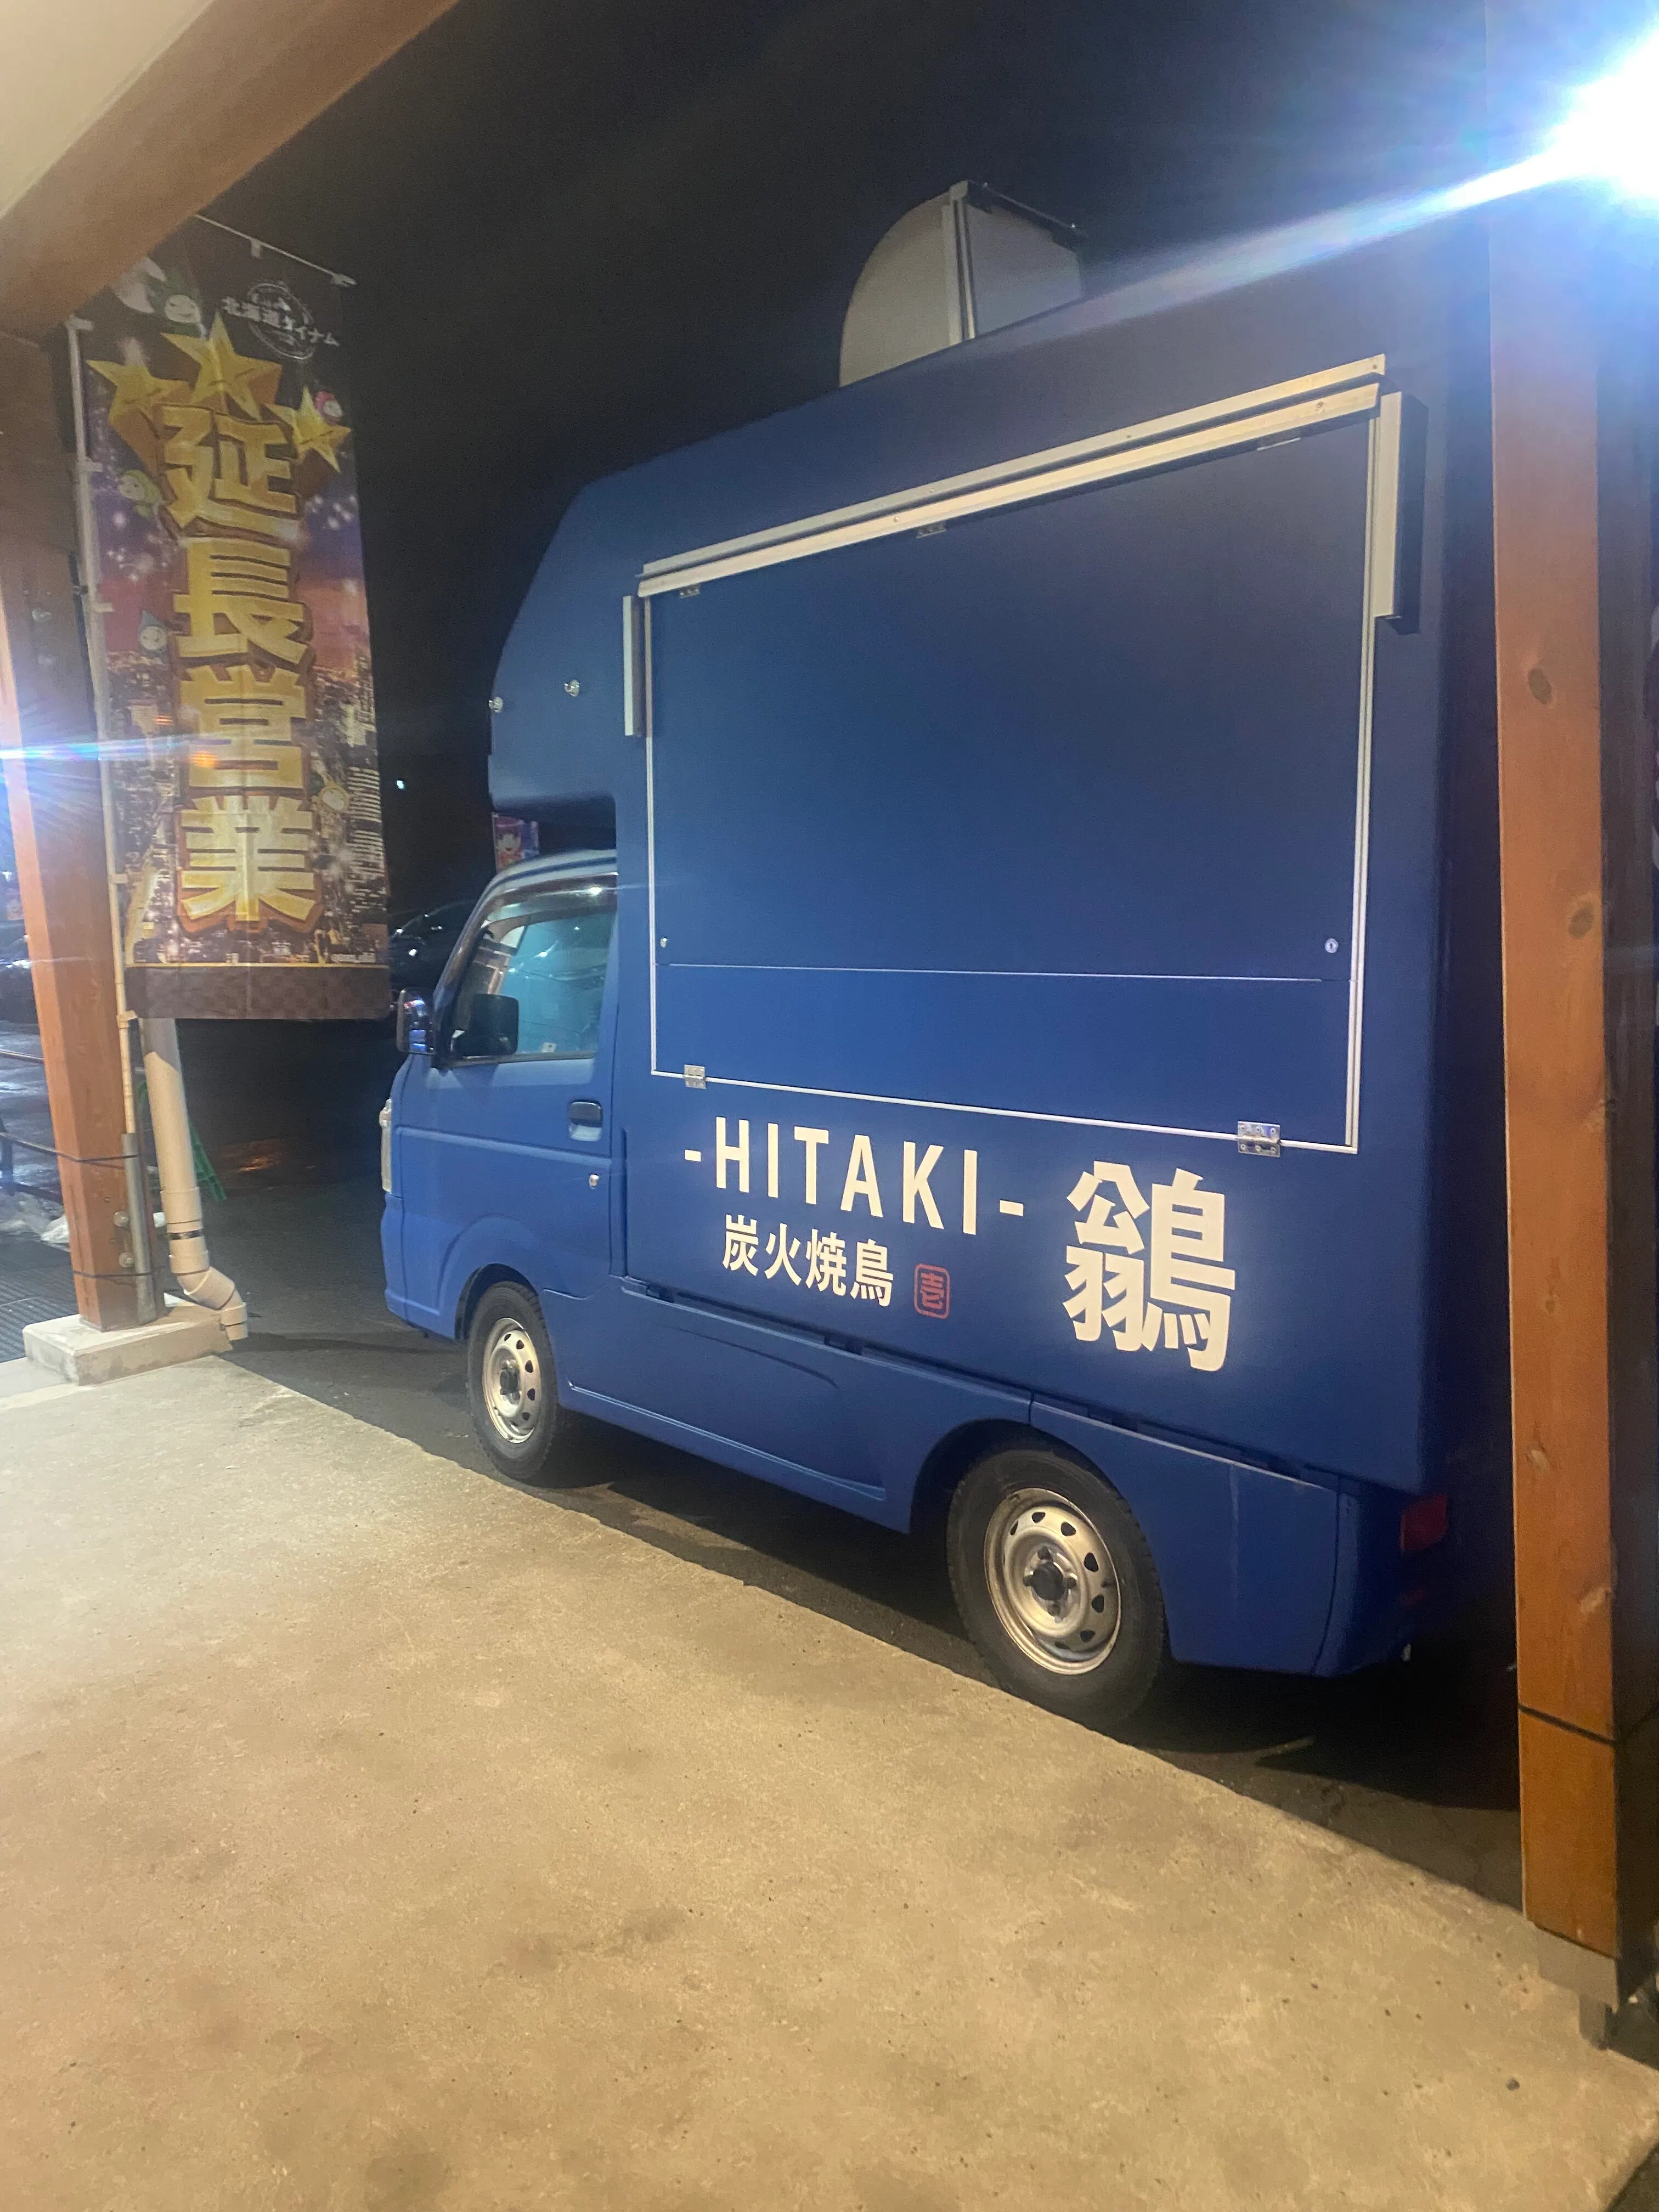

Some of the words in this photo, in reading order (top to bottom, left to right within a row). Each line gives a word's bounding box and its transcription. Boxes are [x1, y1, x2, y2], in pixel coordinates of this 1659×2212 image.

[161, 404, 318, 922] 延長営業
[721, 1214, 894, 1307] 炭火焼鳥
[1062, 1160, 1236, 1372] 鶲
